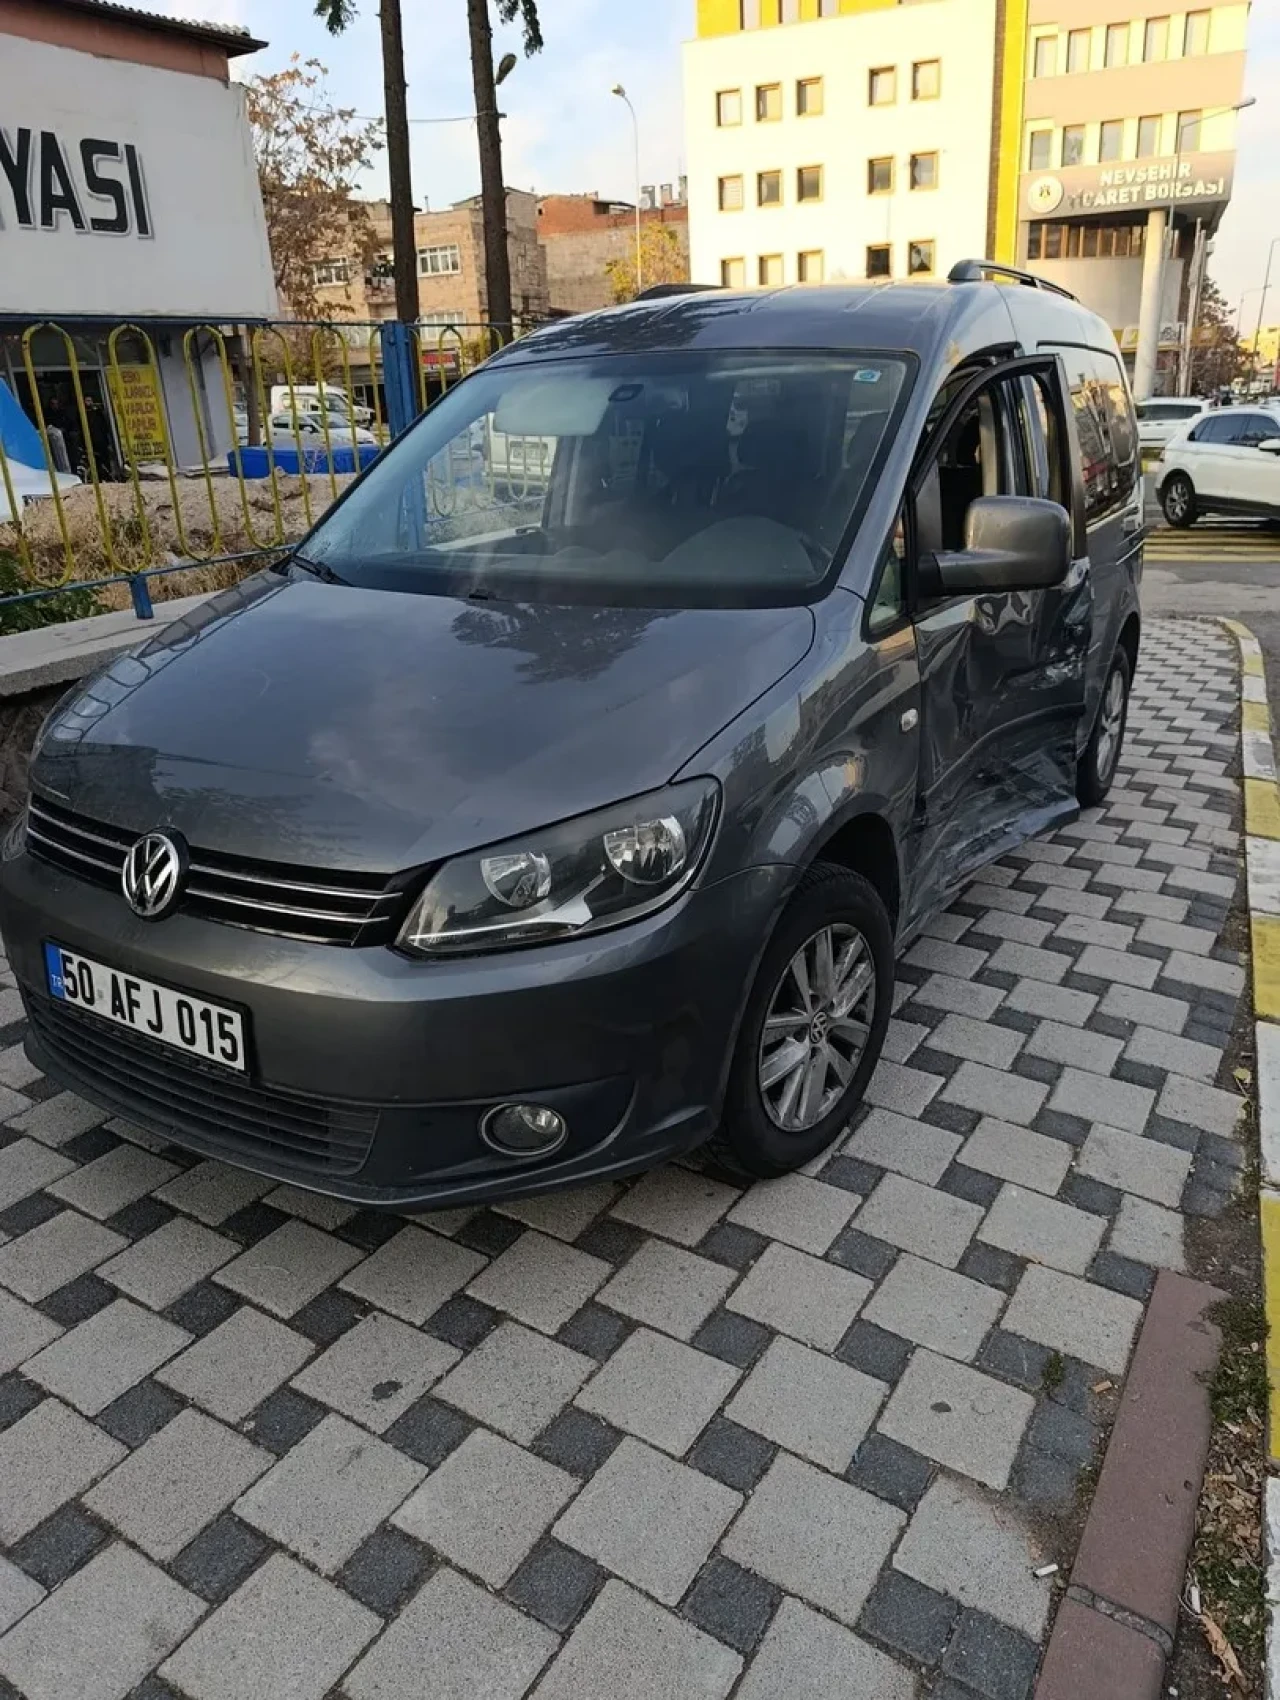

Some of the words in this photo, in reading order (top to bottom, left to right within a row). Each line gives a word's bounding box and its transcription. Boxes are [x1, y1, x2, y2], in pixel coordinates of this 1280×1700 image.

[61, 953, 95, 1007] 50
[111, 973, 163, 1034] AFJ
[176, 999, 239, 1062] 015
